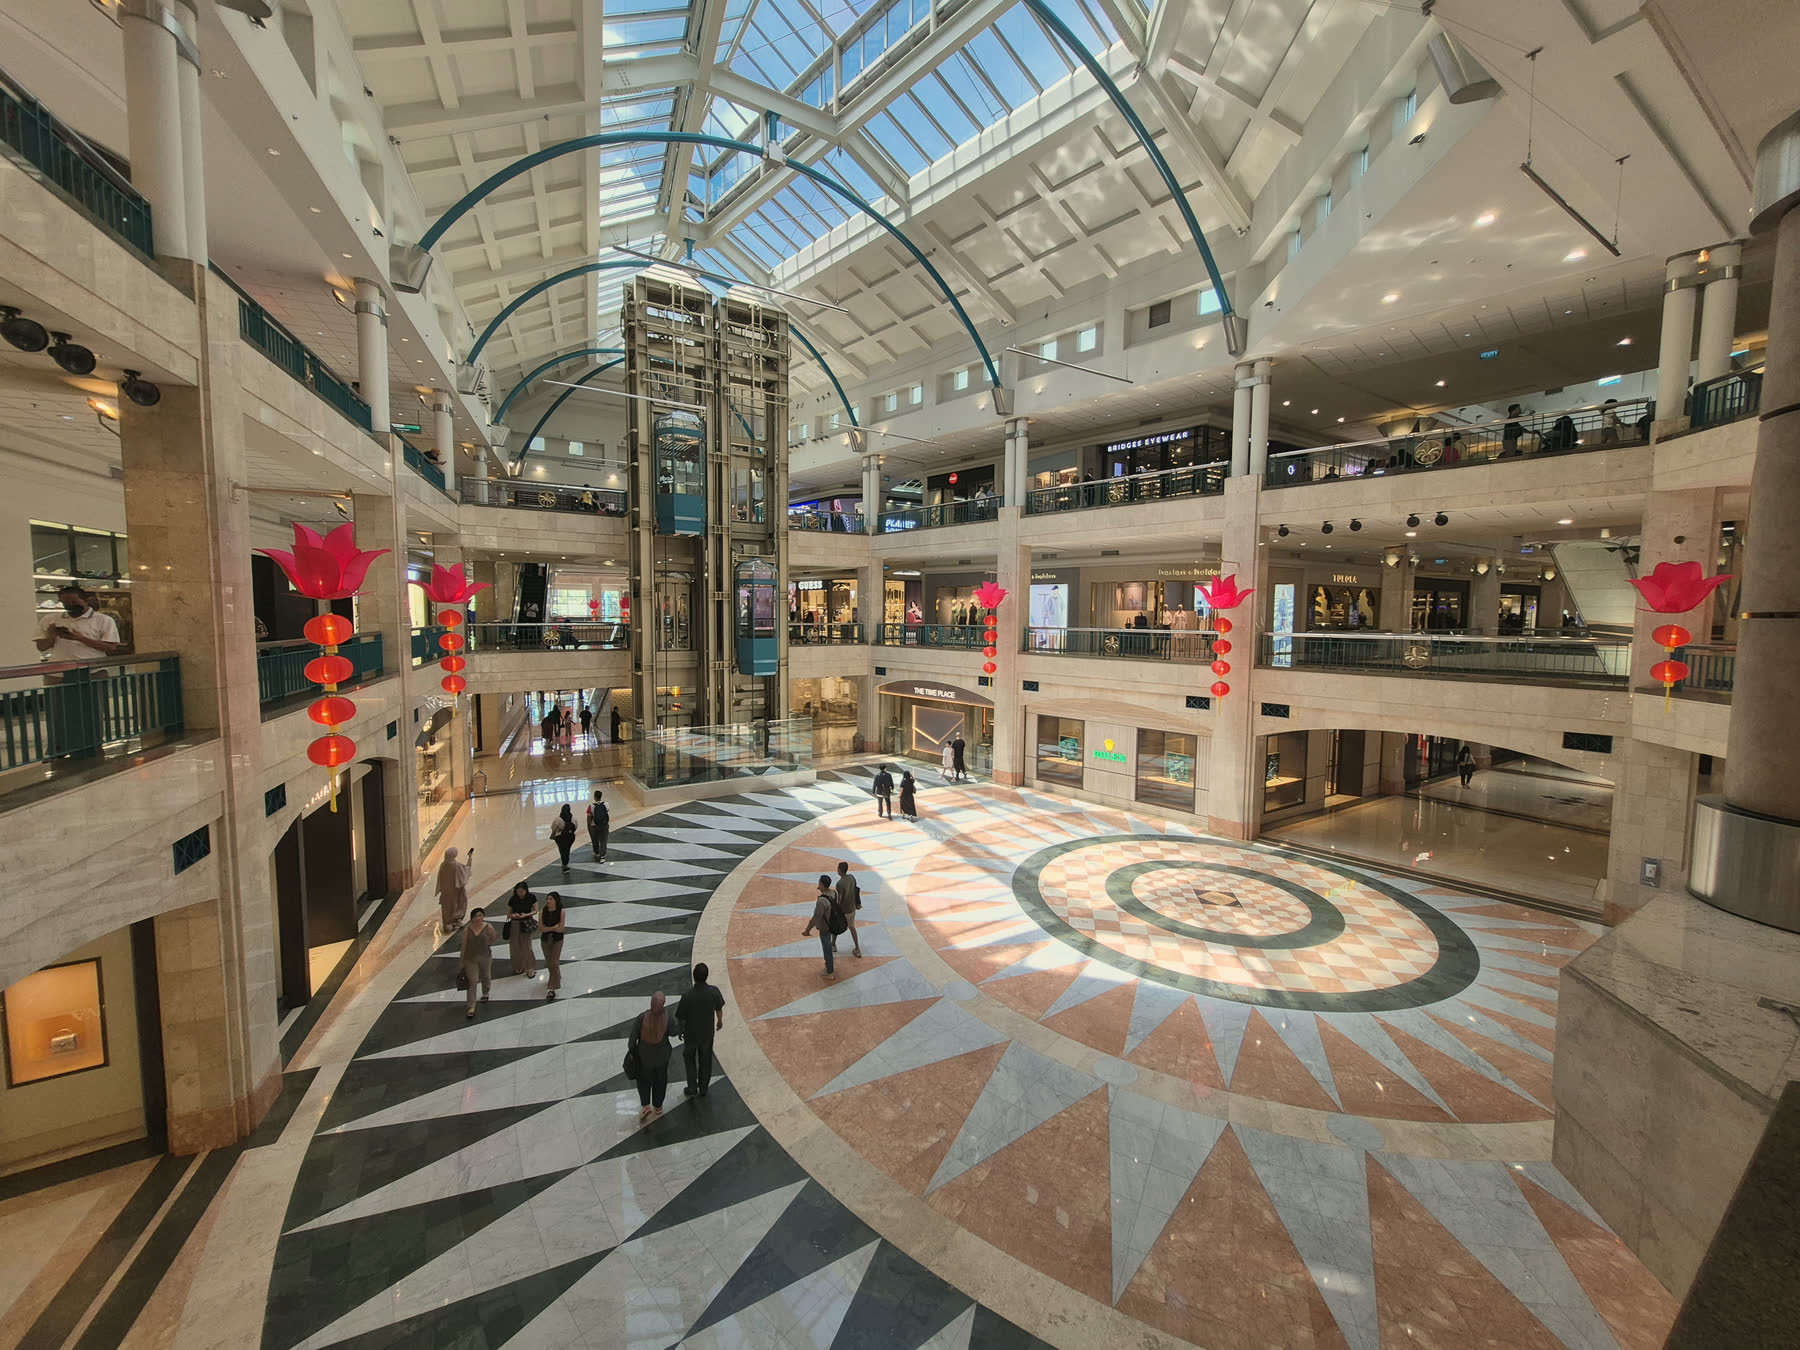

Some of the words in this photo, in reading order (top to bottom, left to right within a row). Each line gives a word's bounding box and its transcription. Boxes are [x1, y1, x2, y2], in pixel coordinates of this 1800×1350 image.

[1107, 440, 1142, 453] BRIDGES
[1144, 431, 1188, 446] EYEWEAR
[798, 580, 823, 590] GUESS
[913, 687, 925, 695] THE
[925, 688, 937, 697] TIME
[937, 690, 956, 699] PLACE
